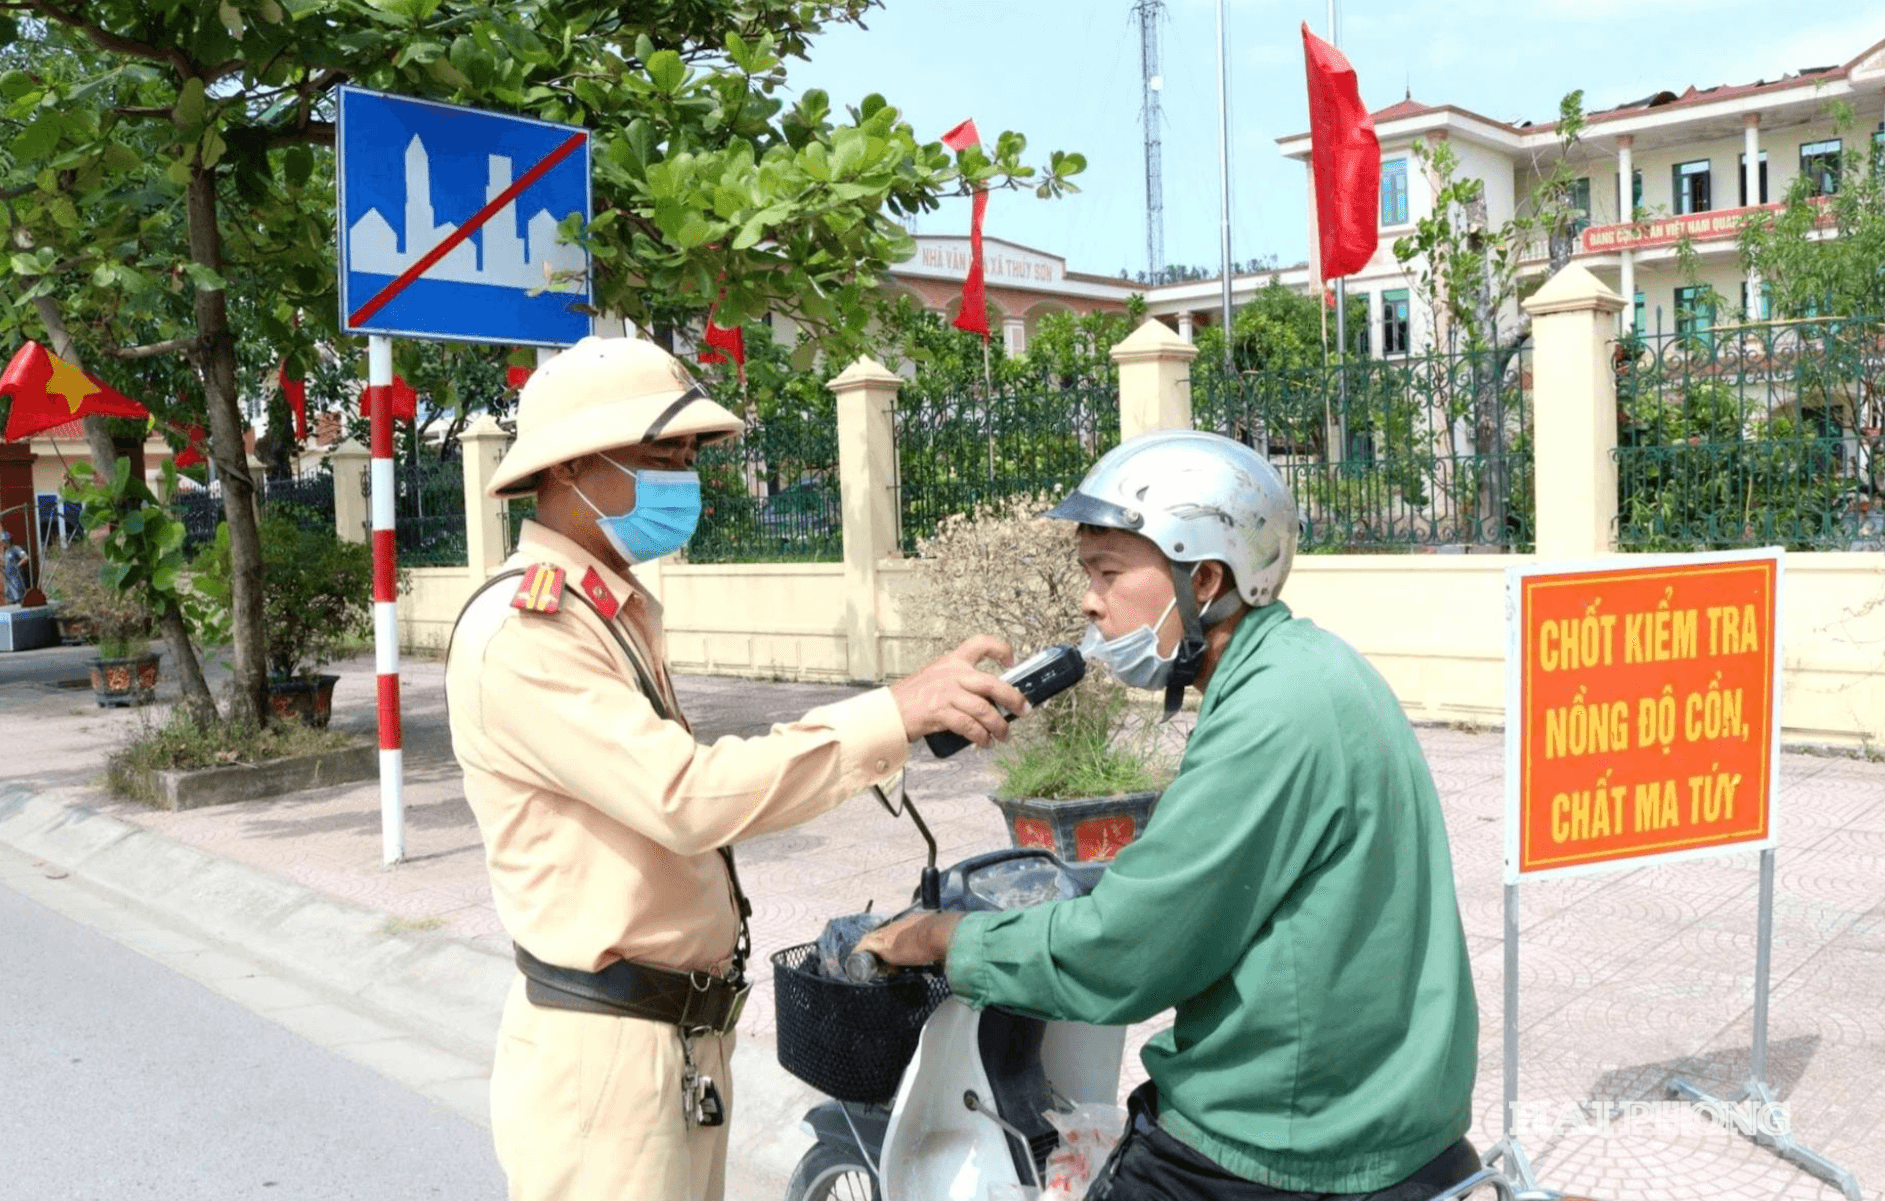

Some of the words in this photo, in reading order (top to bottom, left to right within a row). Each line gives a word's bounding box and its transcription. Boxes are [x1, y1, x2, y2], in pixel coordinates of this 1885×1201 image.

[1539, 596, 1618, 673] CHỐT
[1623, 585, 1699, 665] KIỂM
[1706, 603, 1759, 657] TRA
[1545, 684, 1629, 760] NỒNG
[1637, 684, 1677, 756] ĐỘ
[1684, 670, 1749, 742] CỒN,
[1551, 768, 1628, 844] CHẤT
[1633, 779, 1680, 833] MA
[1688, 762, 1742, 825] TÚY
